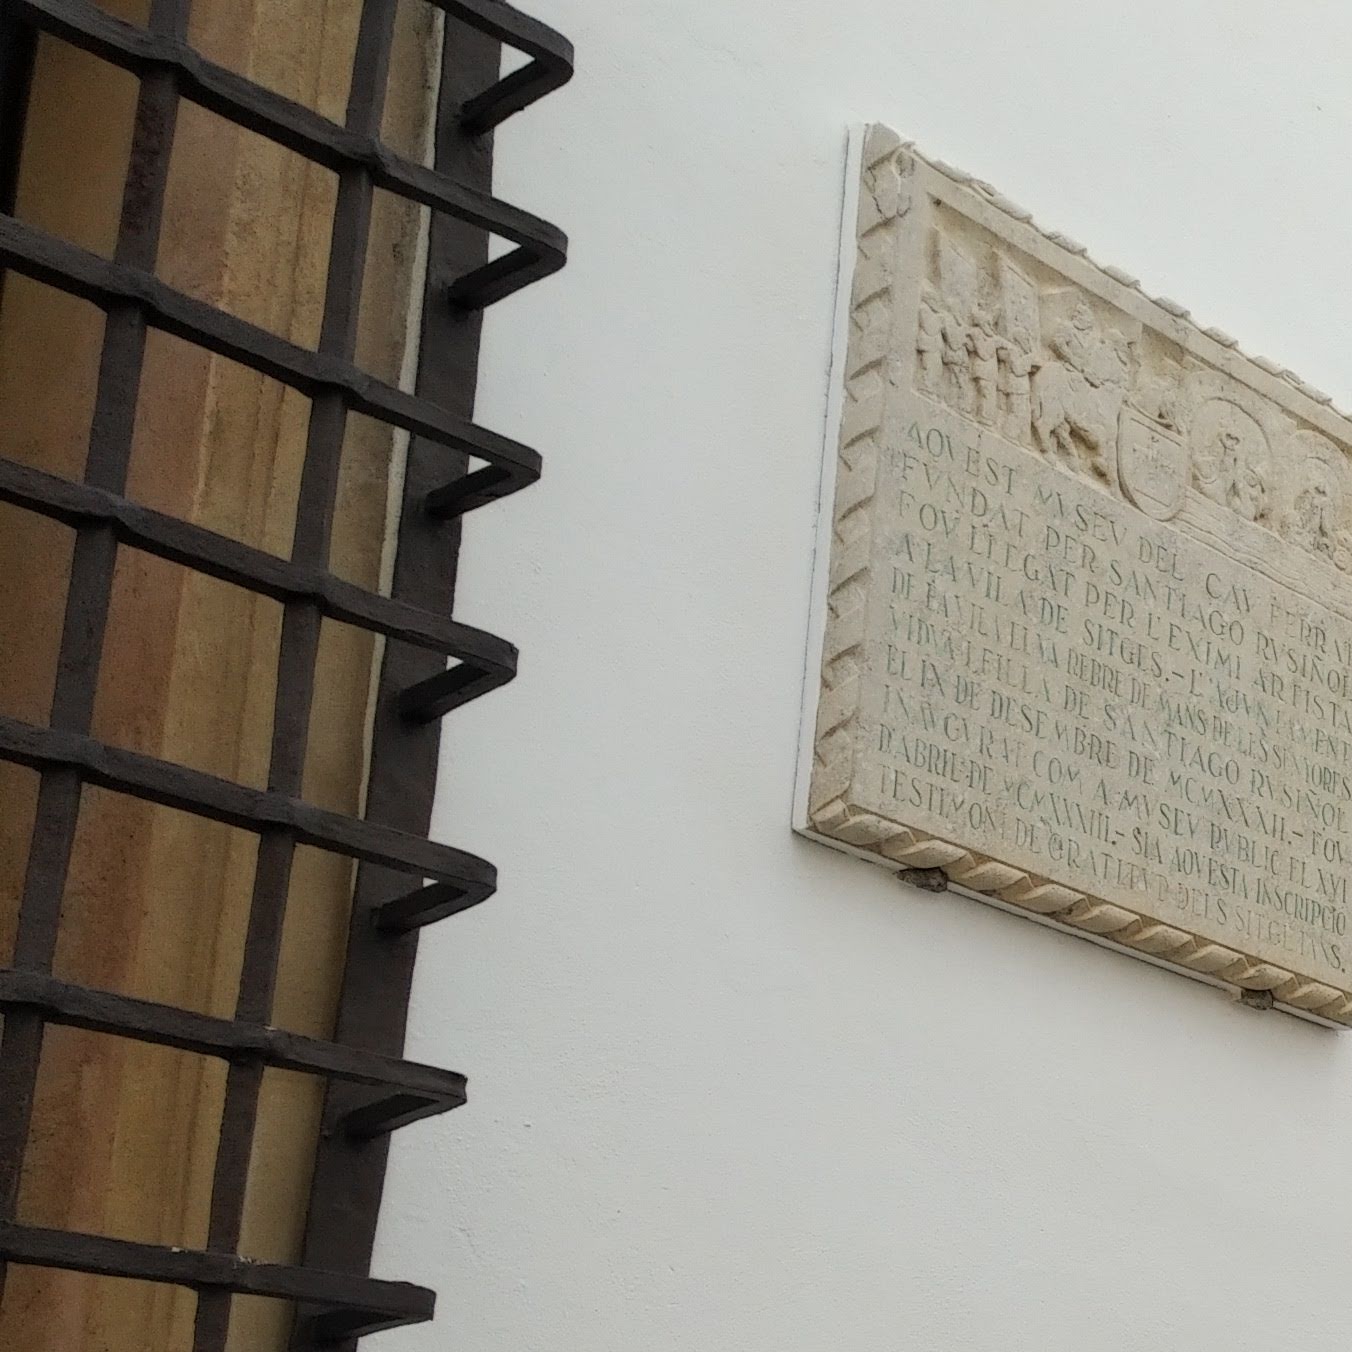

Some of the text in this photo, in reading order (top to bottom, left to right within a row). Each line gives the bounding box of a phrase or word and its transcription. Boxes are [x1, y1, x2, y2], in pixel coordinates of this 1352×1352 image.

[900, 453, 1030, 539] FVNDAT
[1044, 525, 1098, 573] PER
[1107, 558, 1245, 647] SANTIAGO
[1137, 535, 1185, 581] DEL
[1038, 597, 1069, 633] DE
[1083, 582, 1135, 628] PER
[889, 567, 915, 600] DE
[1065, 647, 1122, 696] REBRE
[1128, 677, 1151, 709] DE
[884, 644, 914, 681] EL
[954, 675, 982, 711] DE
[1126, 751, 1155, 785] DE
[1063, 685, 1091, 719] DE
[966, 760, 994, 795] DE
[1014, 818, 1042, 854] DE
